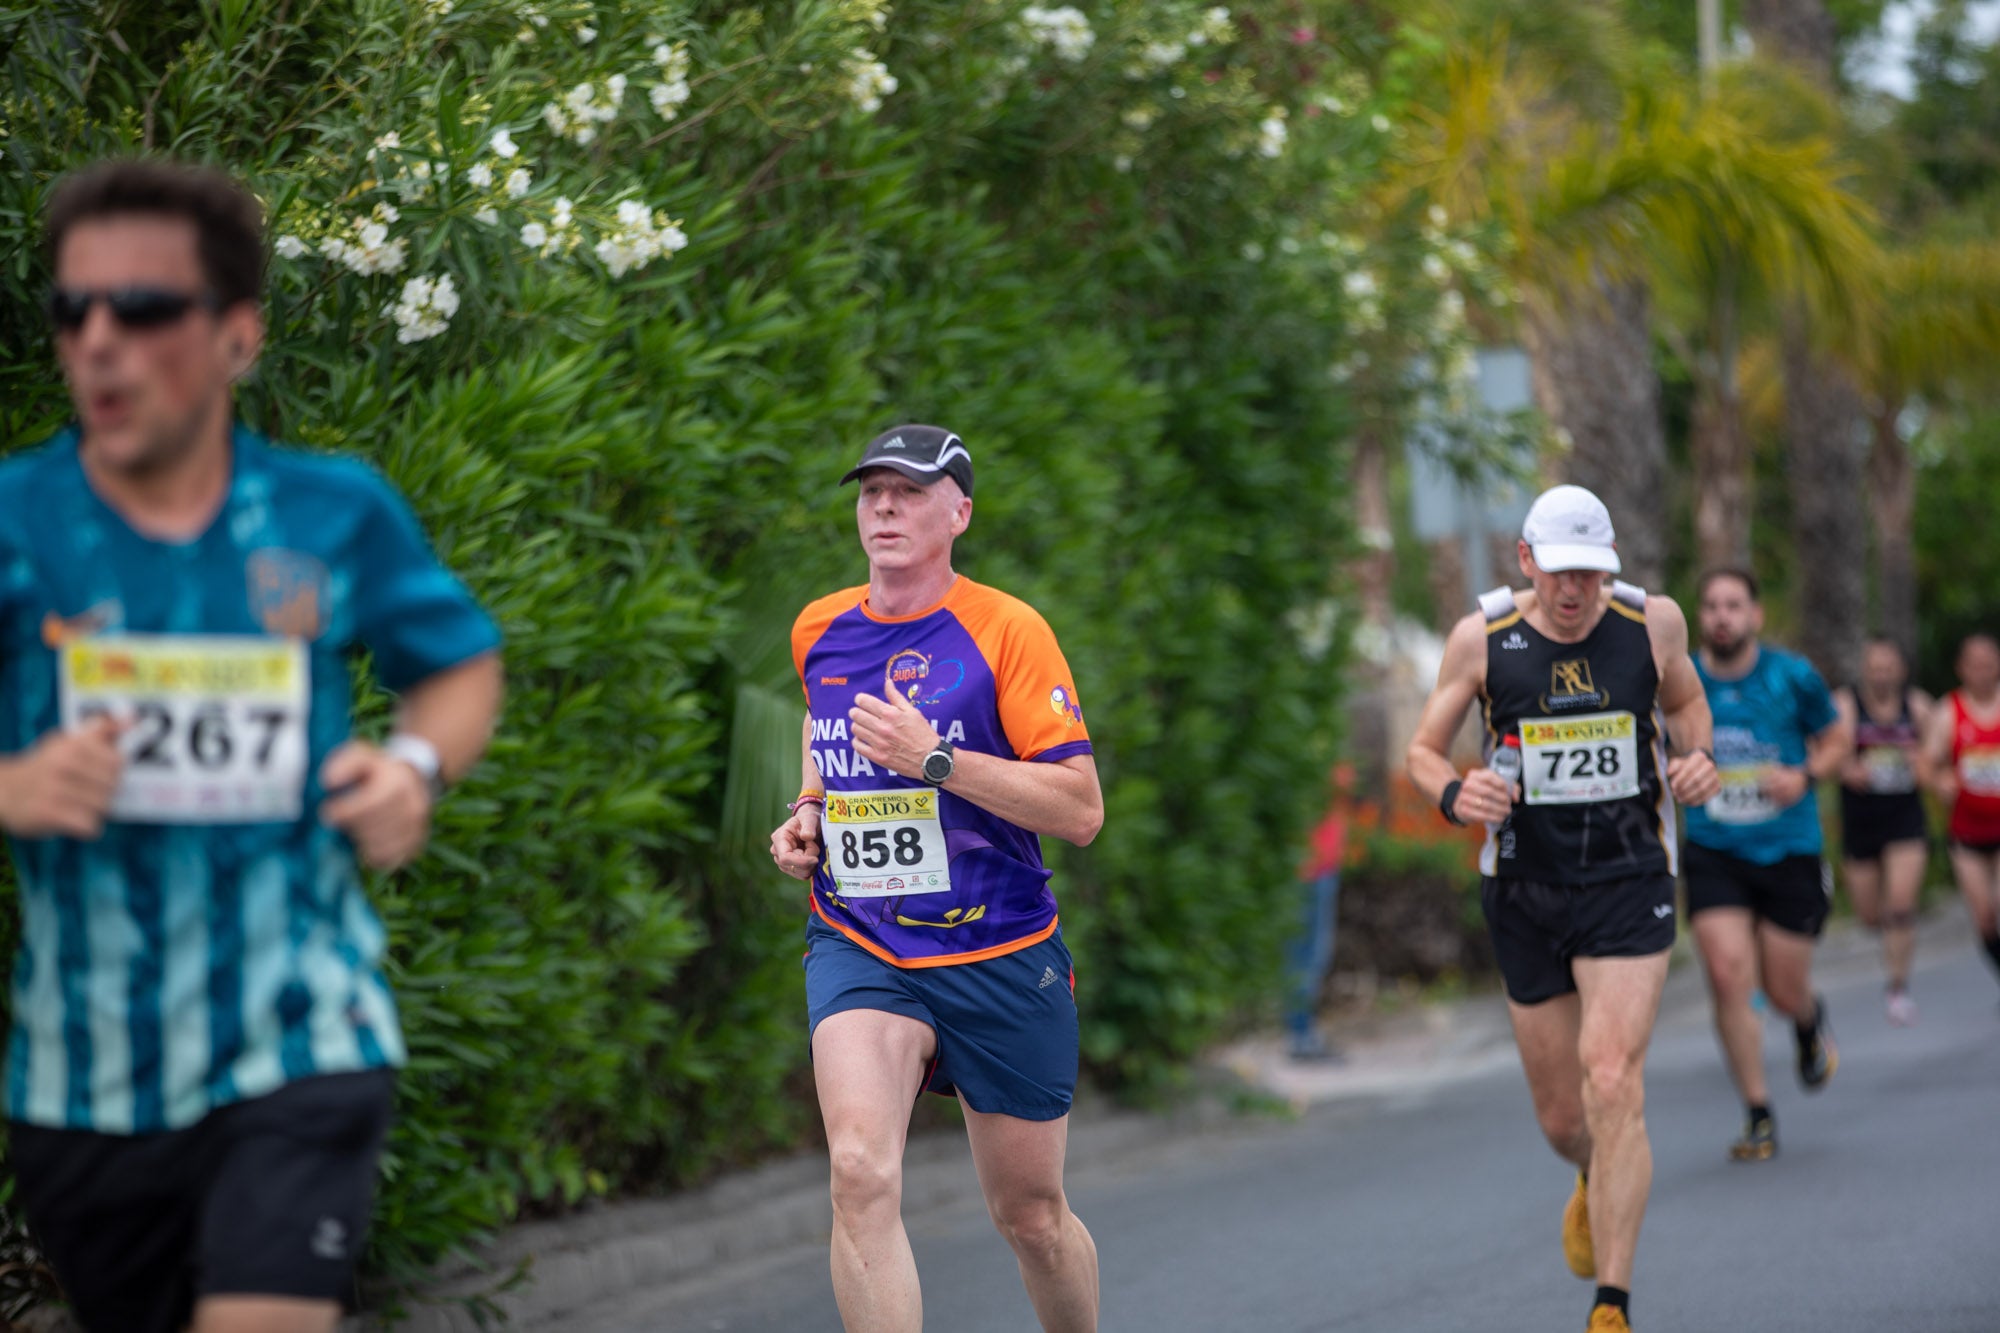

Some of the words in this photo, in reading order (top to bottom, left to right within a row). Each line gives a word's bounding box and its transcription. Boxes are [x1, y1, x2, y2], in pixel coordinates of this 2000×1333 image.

[893, 668, 917, 683] aupa
[79, 702, 288, 770] 267
[1540, 745, 1620, 781] 728
[835, 799, 848, 817] 38
[848, 797, 870, 805] GRAN
[871, 796, 902, 804] PREMIO
[847, 802, 910, 818] FONDO
[841, 826, 924, 869] 858
